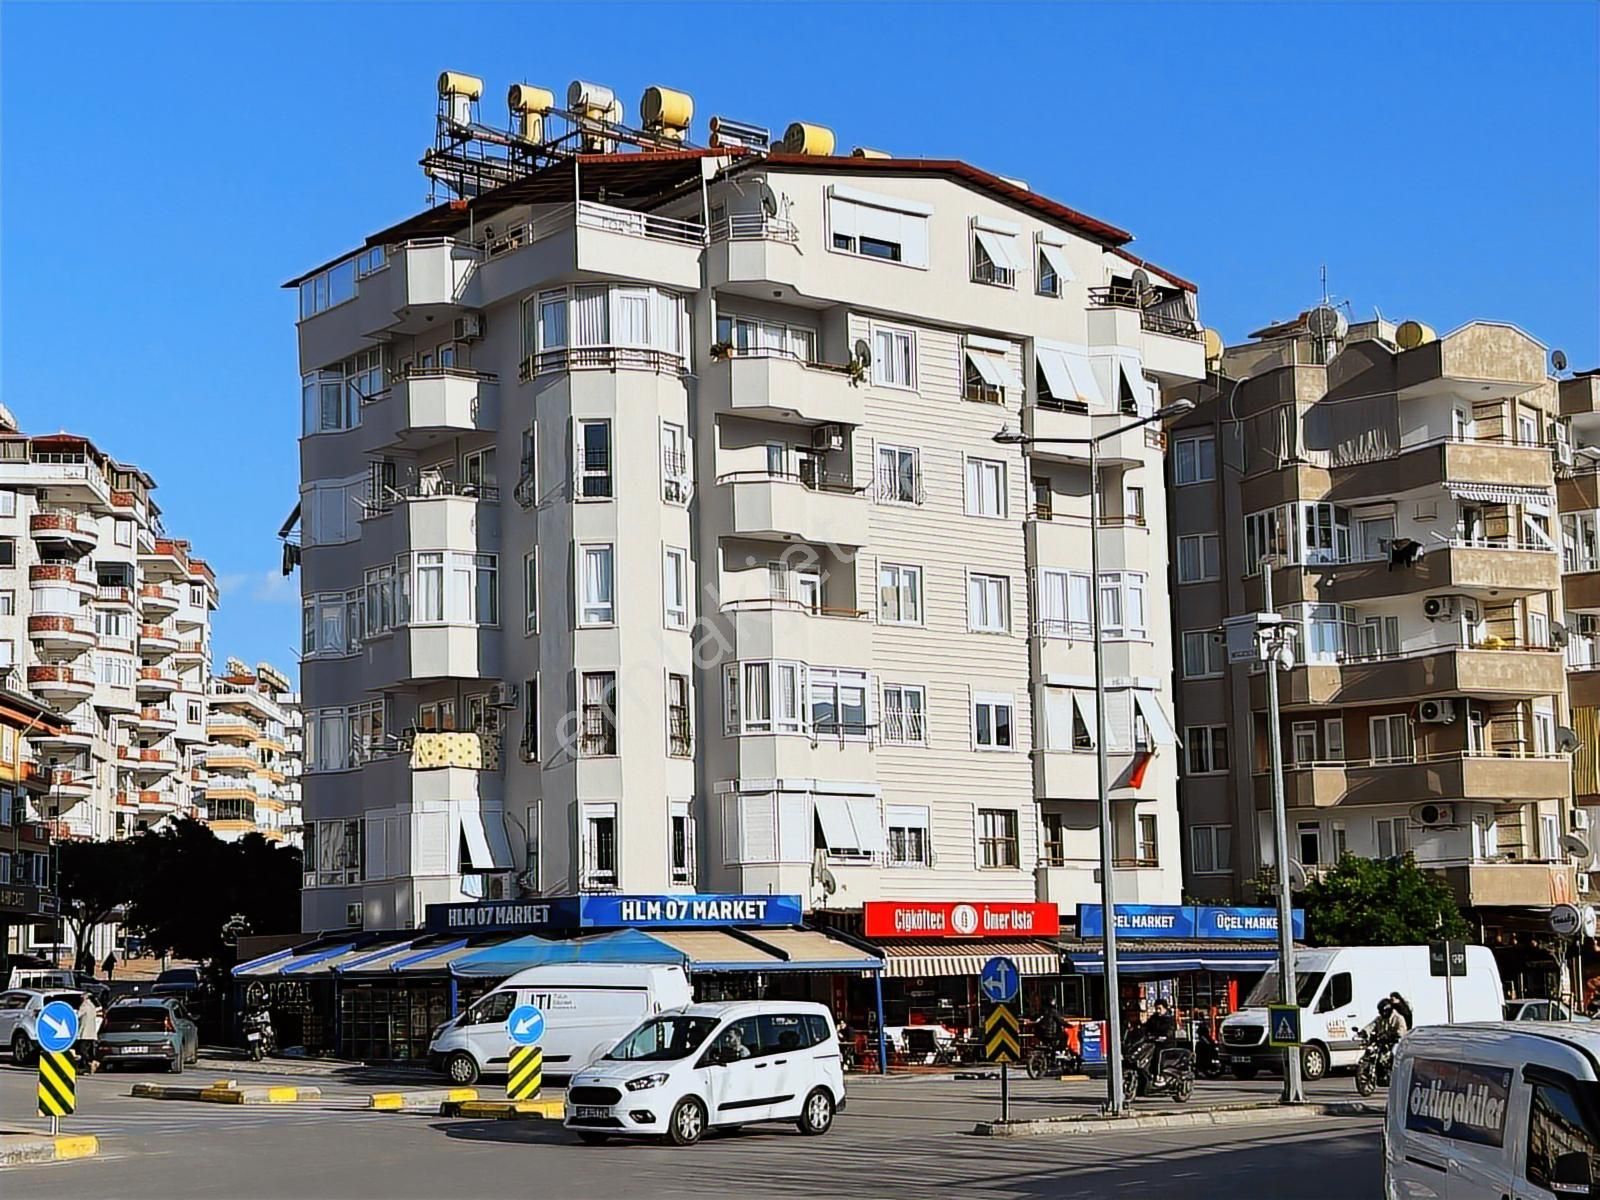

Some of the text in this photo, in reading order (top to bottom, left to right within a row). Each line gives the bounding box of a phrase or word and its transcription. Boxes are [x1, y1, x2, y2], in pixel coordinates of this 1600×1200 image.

[448, 904, 551, 927] HLM 07 MARKET
[621, 900, 768, 921] HLM 07 MARKET
[894, 904, 1034, 933] Çiğköfteci Ömer Usta
[1132, 915, 1175, 929] MARKET
[1244, 916, 1280, 930] MARKE
